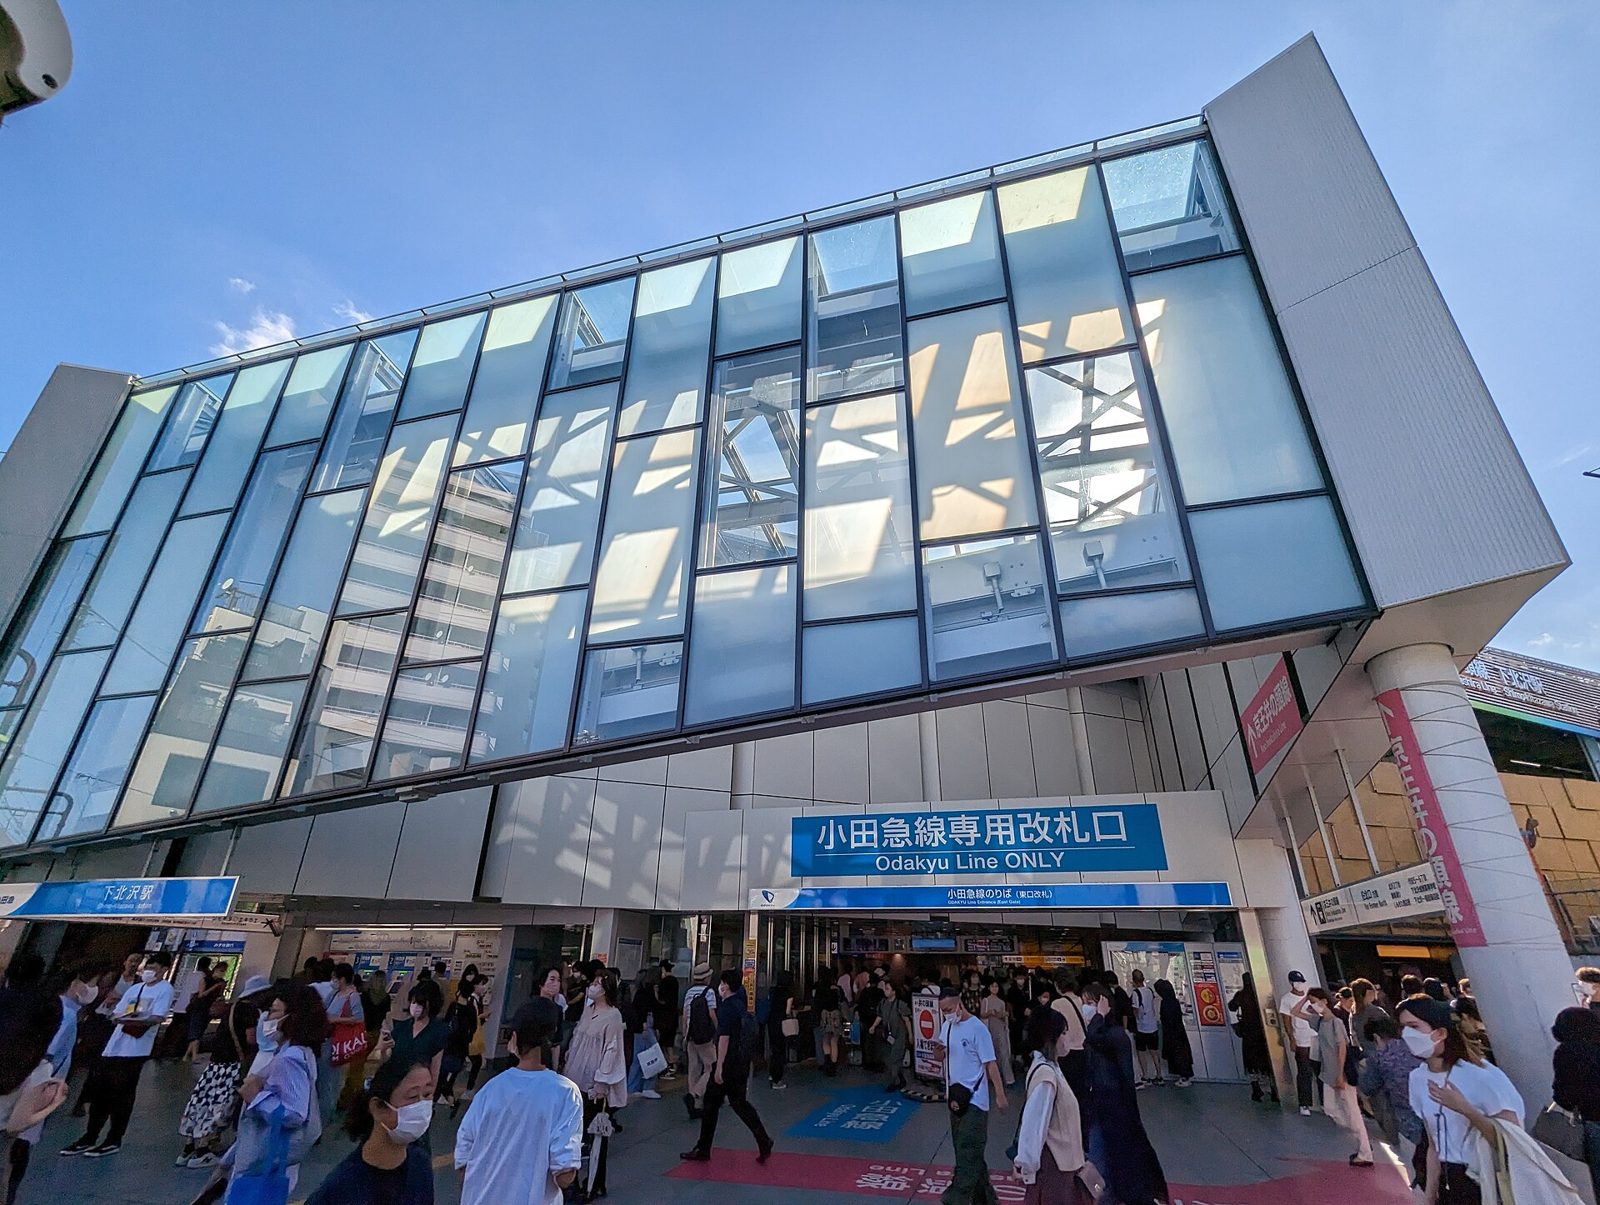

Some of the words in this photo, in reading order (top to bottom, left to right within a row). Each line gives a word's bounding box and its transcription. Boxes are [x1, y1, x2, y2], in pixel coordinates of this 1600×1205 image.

[1253, 674, 1292, 738] 京王井の頭線
[817, 810, 1127, 851] 小田急線専用改札口
[875, 855, 949, 874] Odakyu
[957, 854, 999, 869] Line
[1005, 851, 1066, 868] ONLY
[103, 884, 154, 901] 下北沢駅
[869, 1164, 926, 1176] Line
